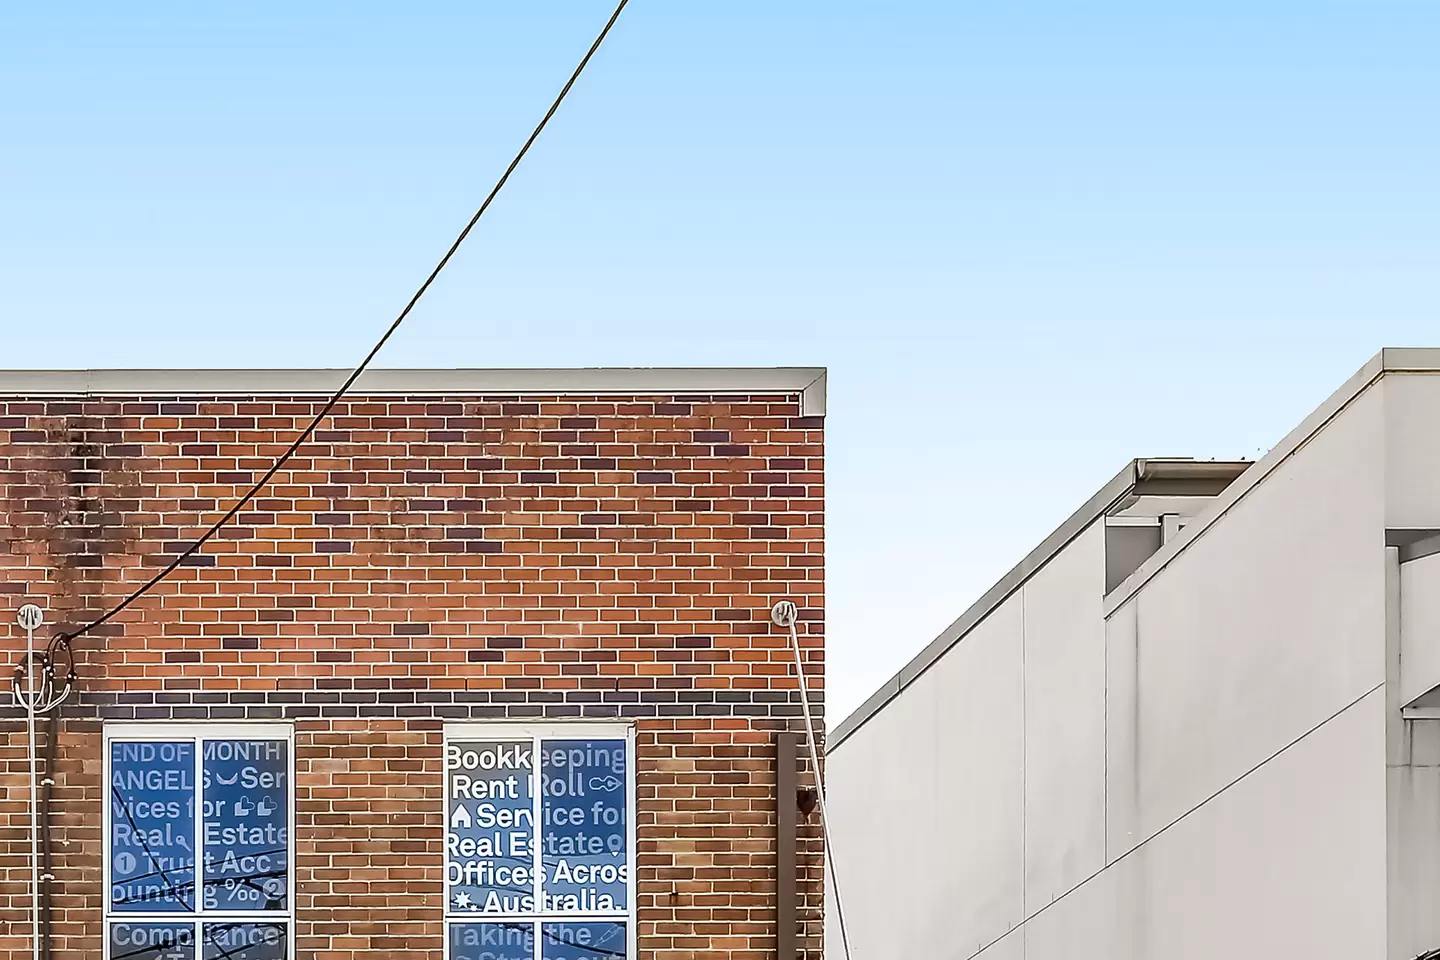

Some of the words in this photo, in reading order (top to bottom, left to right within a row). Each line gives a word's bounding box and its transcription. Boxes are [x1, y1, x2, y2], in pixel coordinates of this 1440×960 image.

[112, 744, 156, 761] END
[160, 743, 189, 762] OF
[204, 742, 279, 760] MONTH
[448, 744, 624, 774] Bookkeeping
[112, 769, 211, 790] ANGELS
[240, 767, 285, 789] Ser
[452, 774, 518, 799] Rent
[527, 773, 585, 798] Roll
[112, 797, 180, 818] vices
[477, 802, 584, 828] Service
[114, 823, 173, 846] Real
[205, 823, 287, 845] Estate
[448, 832, 502, 857] Real
[449, 860, 547, 885] Offices
[552, 860, 626, 884] Acros
[452, 923, 533, 952] Taking
[549, 923, 591, 945] the
